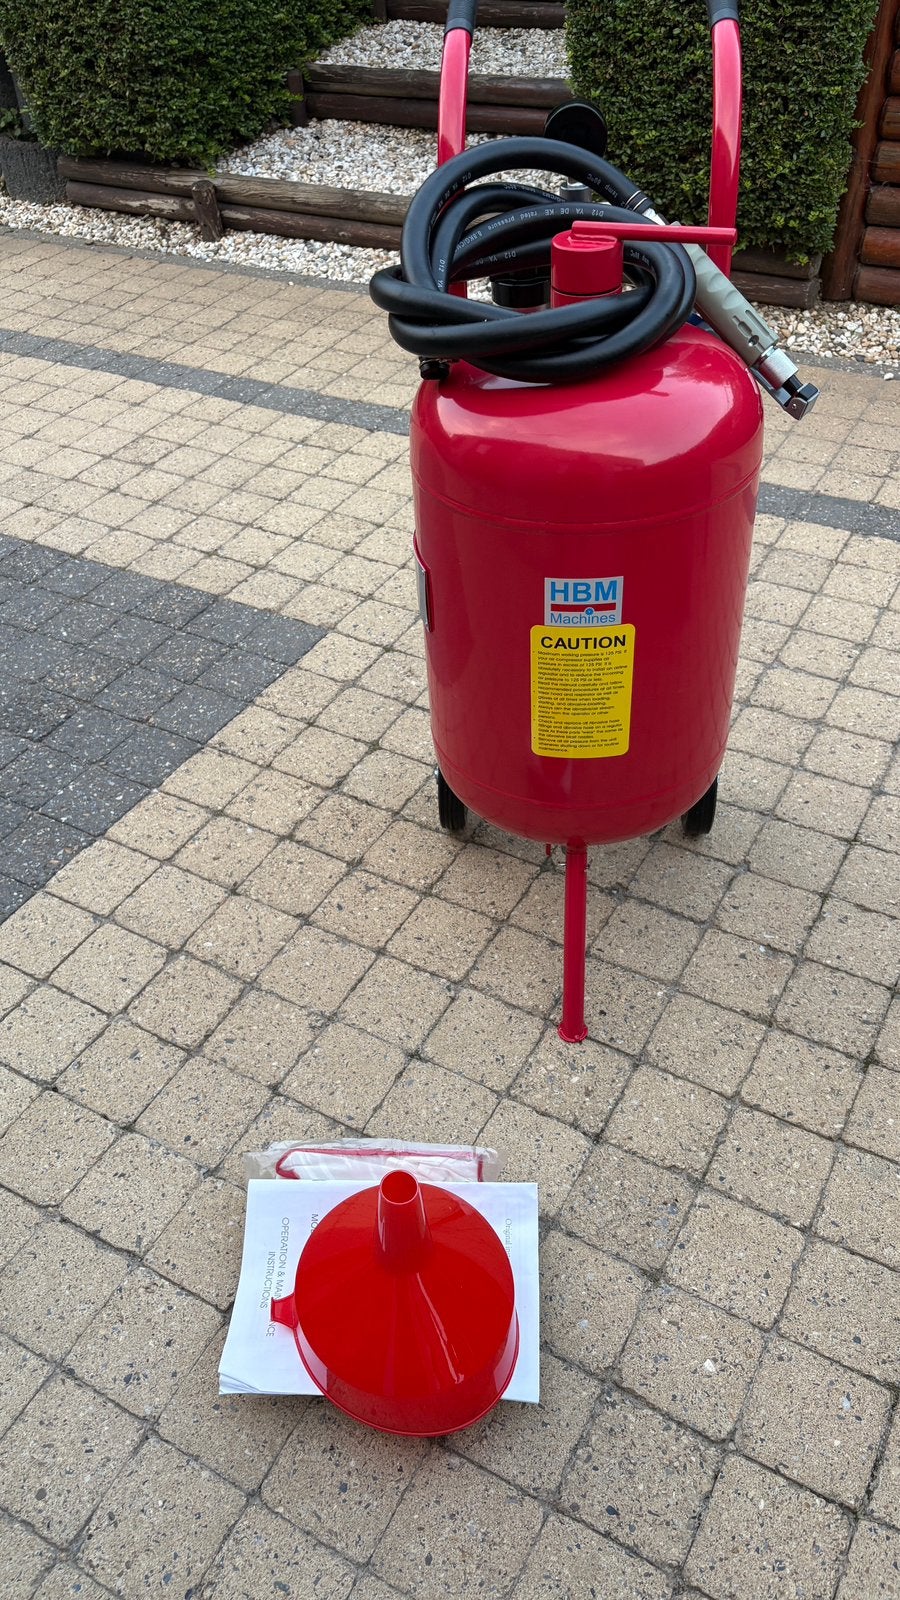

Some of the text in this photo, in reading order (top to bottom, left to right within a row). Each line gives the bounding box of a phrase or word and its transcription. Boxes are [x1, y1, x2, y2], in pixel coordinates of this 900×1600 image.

[520, 210, 538, 220] rated
[592, 208, 604, 216] D12
[487, 216, 515, 230] pressure
[550, 580, 617, 603] HBM
[550, 612, 616, 625] Machines
[540, 634, 626, 650] CAUTION
[310, 1213, 319, 1234] MO
[503, 1218, 512, 1245] Original
[278, 1216, 290, 1269] OPERATION
[260, 1251, 276, 1309] INSTRUCTIONS
